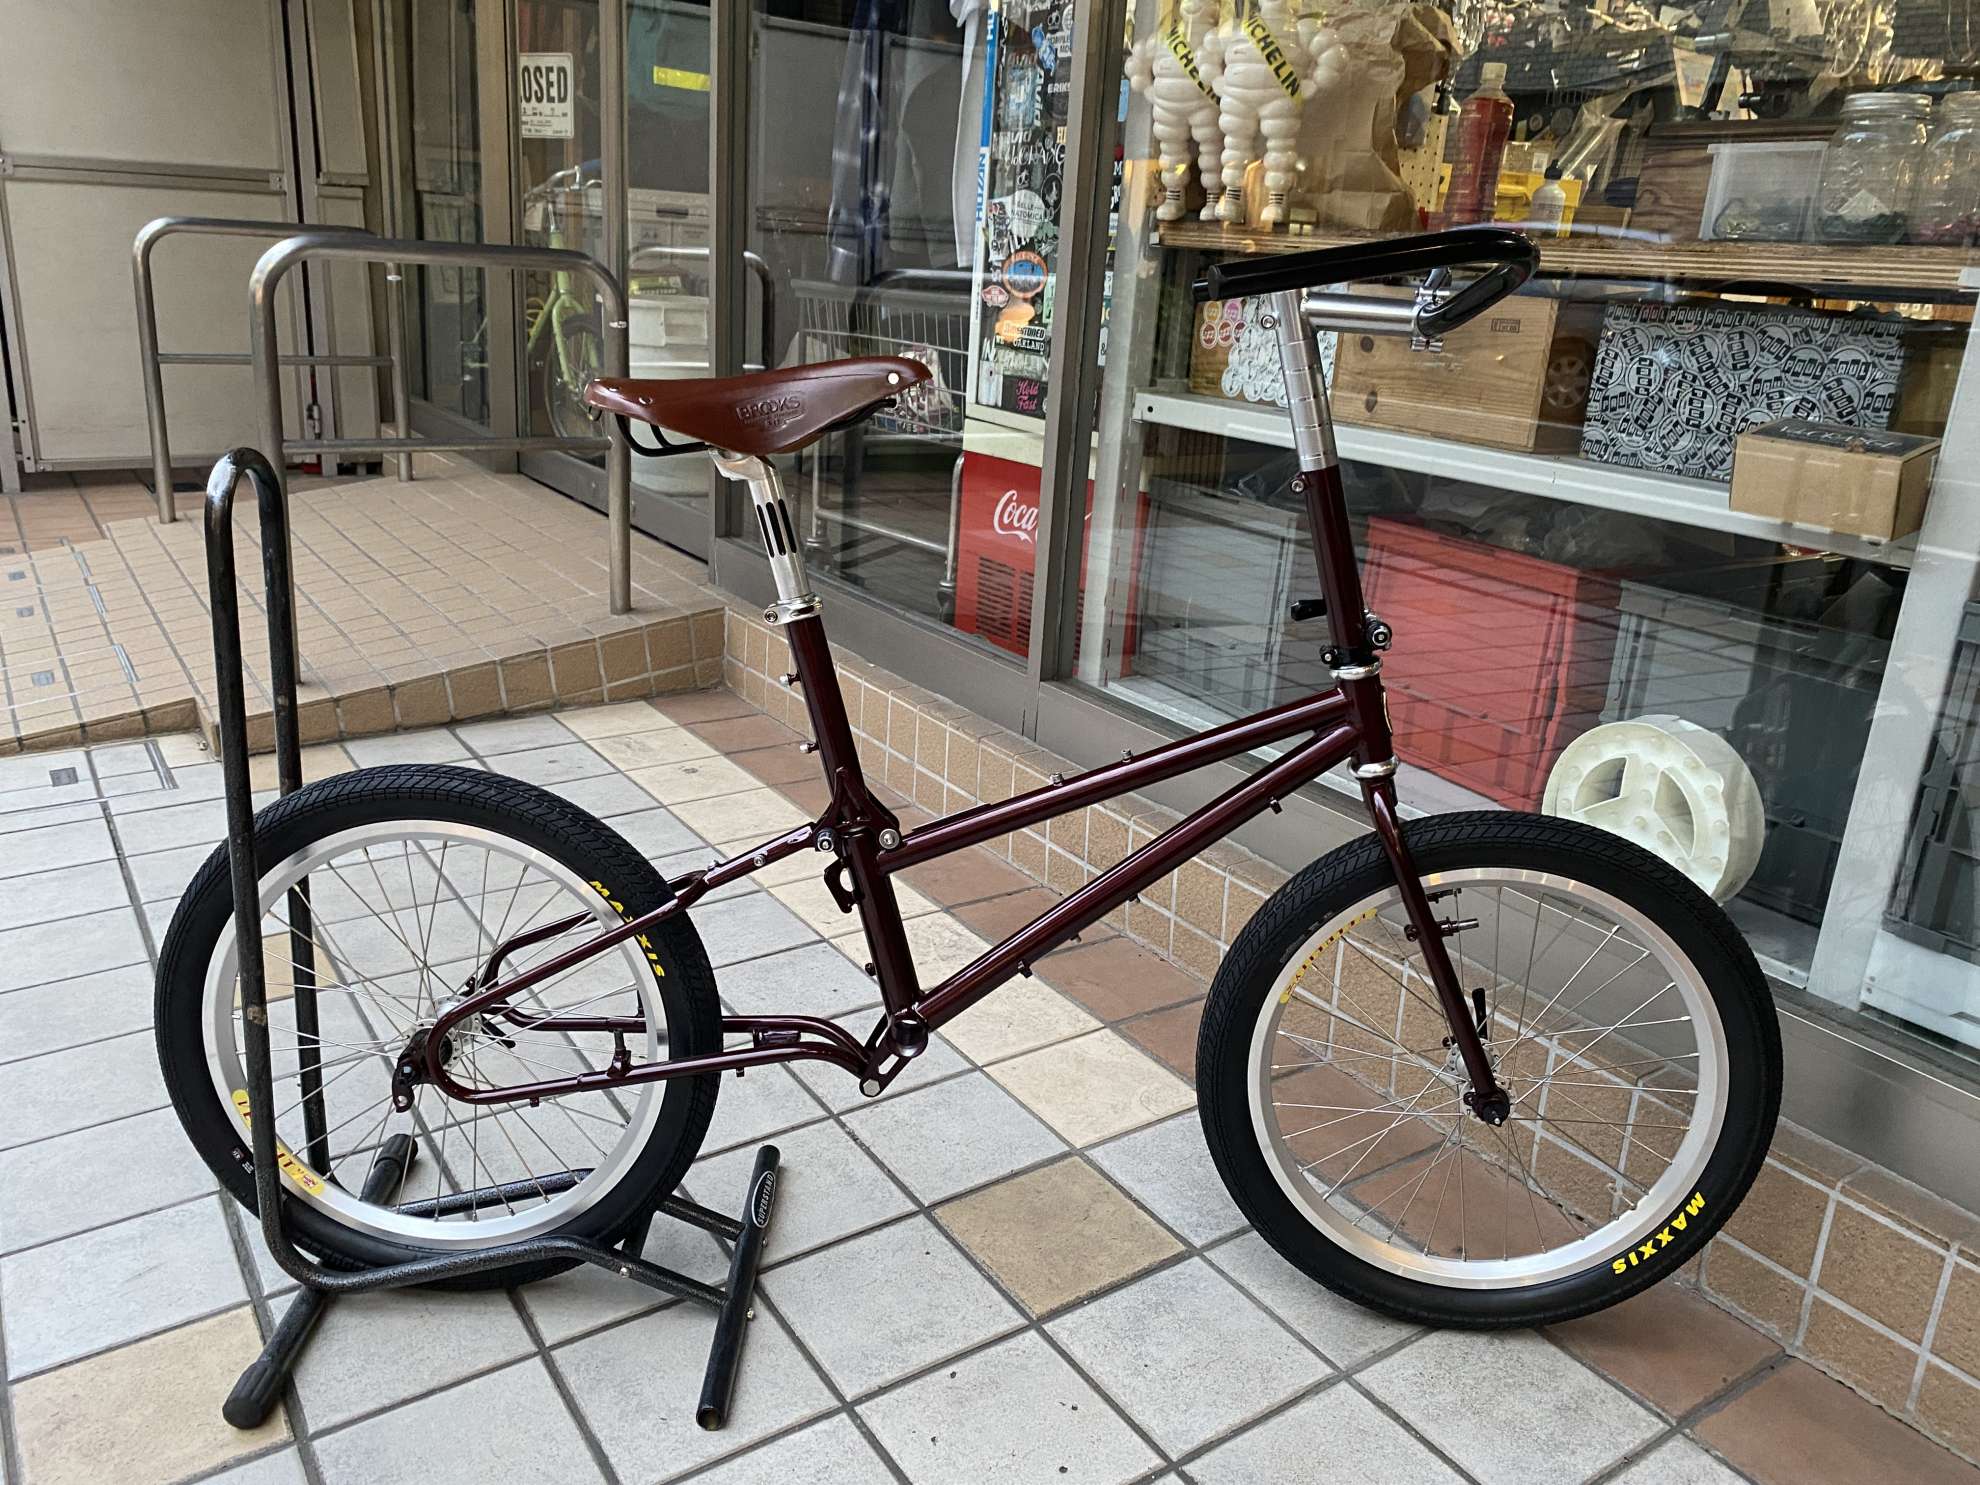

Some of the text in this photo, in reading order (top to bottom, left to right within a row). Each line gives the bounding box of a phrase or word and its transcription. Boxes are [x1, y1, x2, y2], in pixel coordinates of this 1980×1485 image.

[1247, 16, 1300, 97] ICHELIN
[520, 65, 568, 104] OSED
[974, 153, 986, 221] HOZAN
[1016, 380, 1040, 396] Hold
[1783, 355, 1827, 381] PAUL
[736, 396, 801, 420] BROOKS
[1016, 396, 1037, 410] Fast
[1685, 387, 1708, 429] PAUL
[1822, 377, 1861, 423] PAUL
[1860, 392, 1895, 414] PAU
[757, 1173, 774, 1225] SUPERSTAND
[1612, 1191, 1706, 1275] MAXXIS
